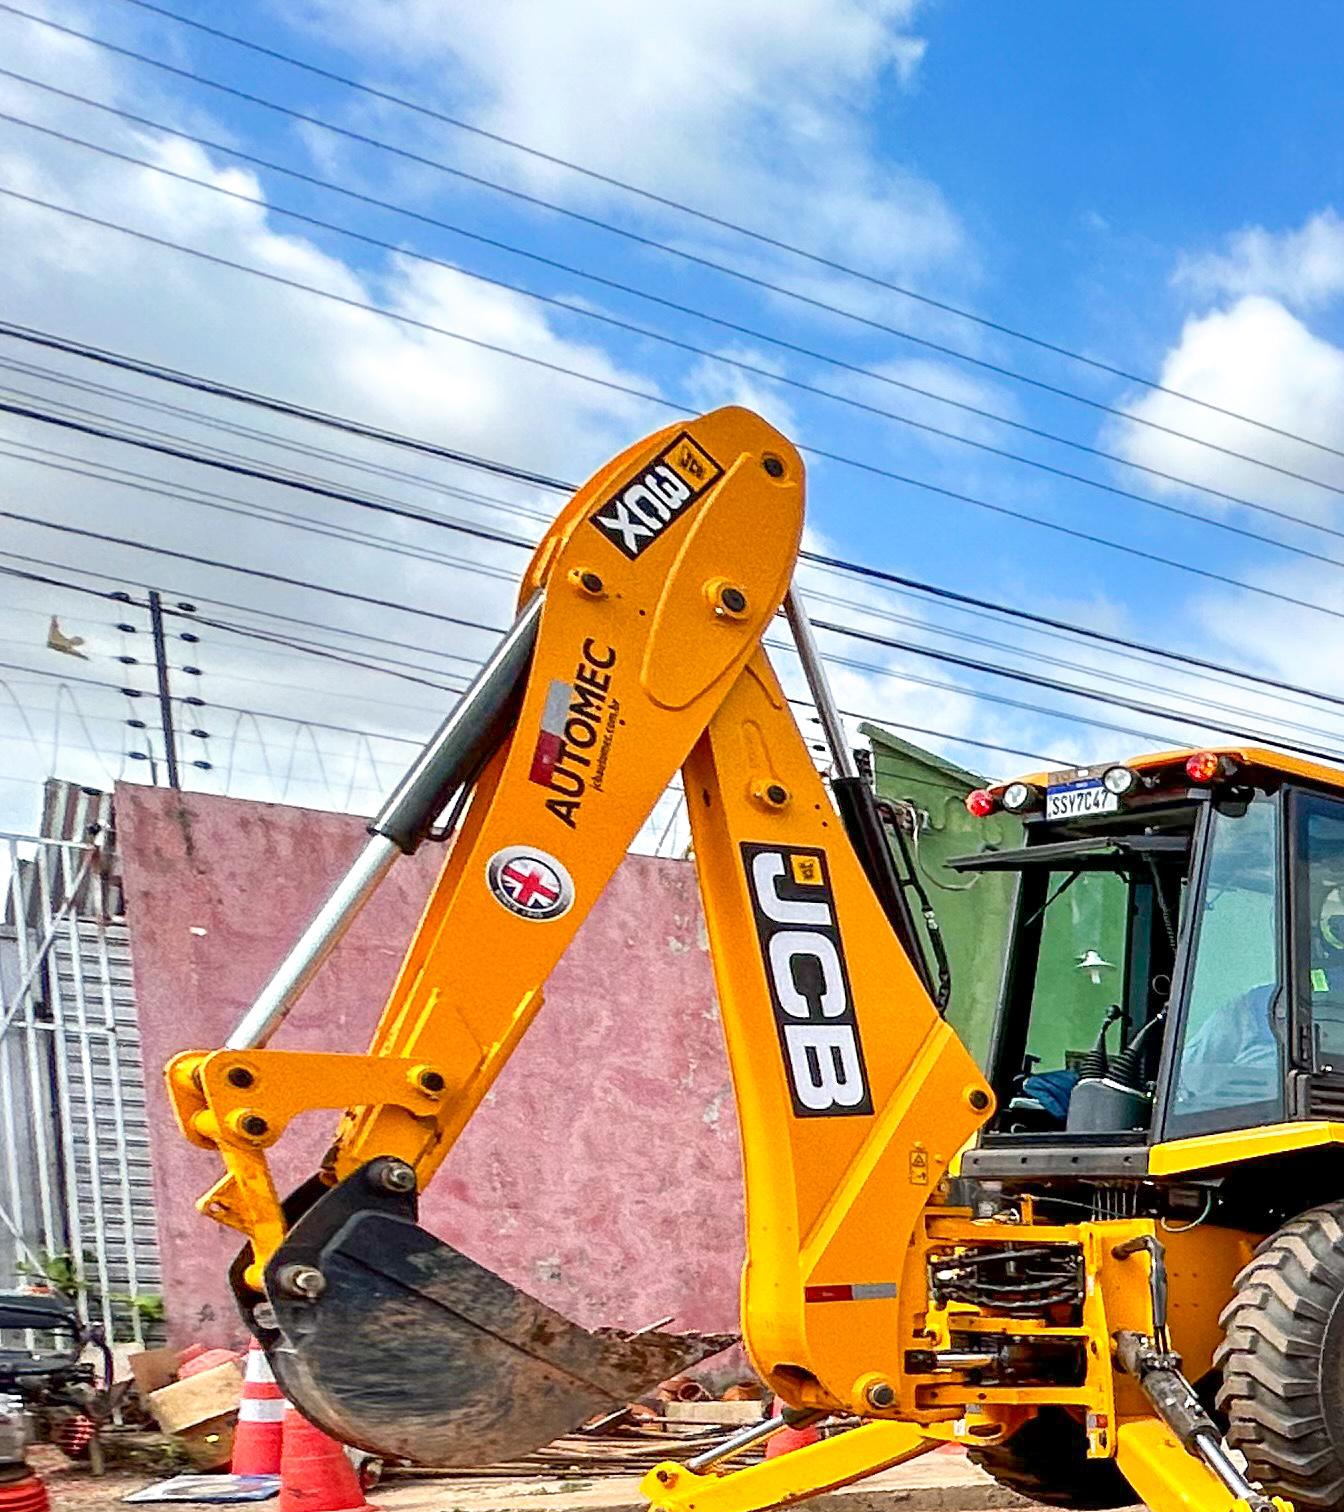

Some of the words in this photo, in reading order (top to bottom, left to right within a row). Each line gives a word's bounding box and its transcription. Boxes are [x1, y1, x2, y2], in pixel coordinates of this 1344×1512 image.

[594, 465, 692, 556] 3CX
[544, 637, 617, 830] AUTOMEC
[1052, 789, 1108, 816] SSY7C47
[752, 852, 865, 1110] JCB
